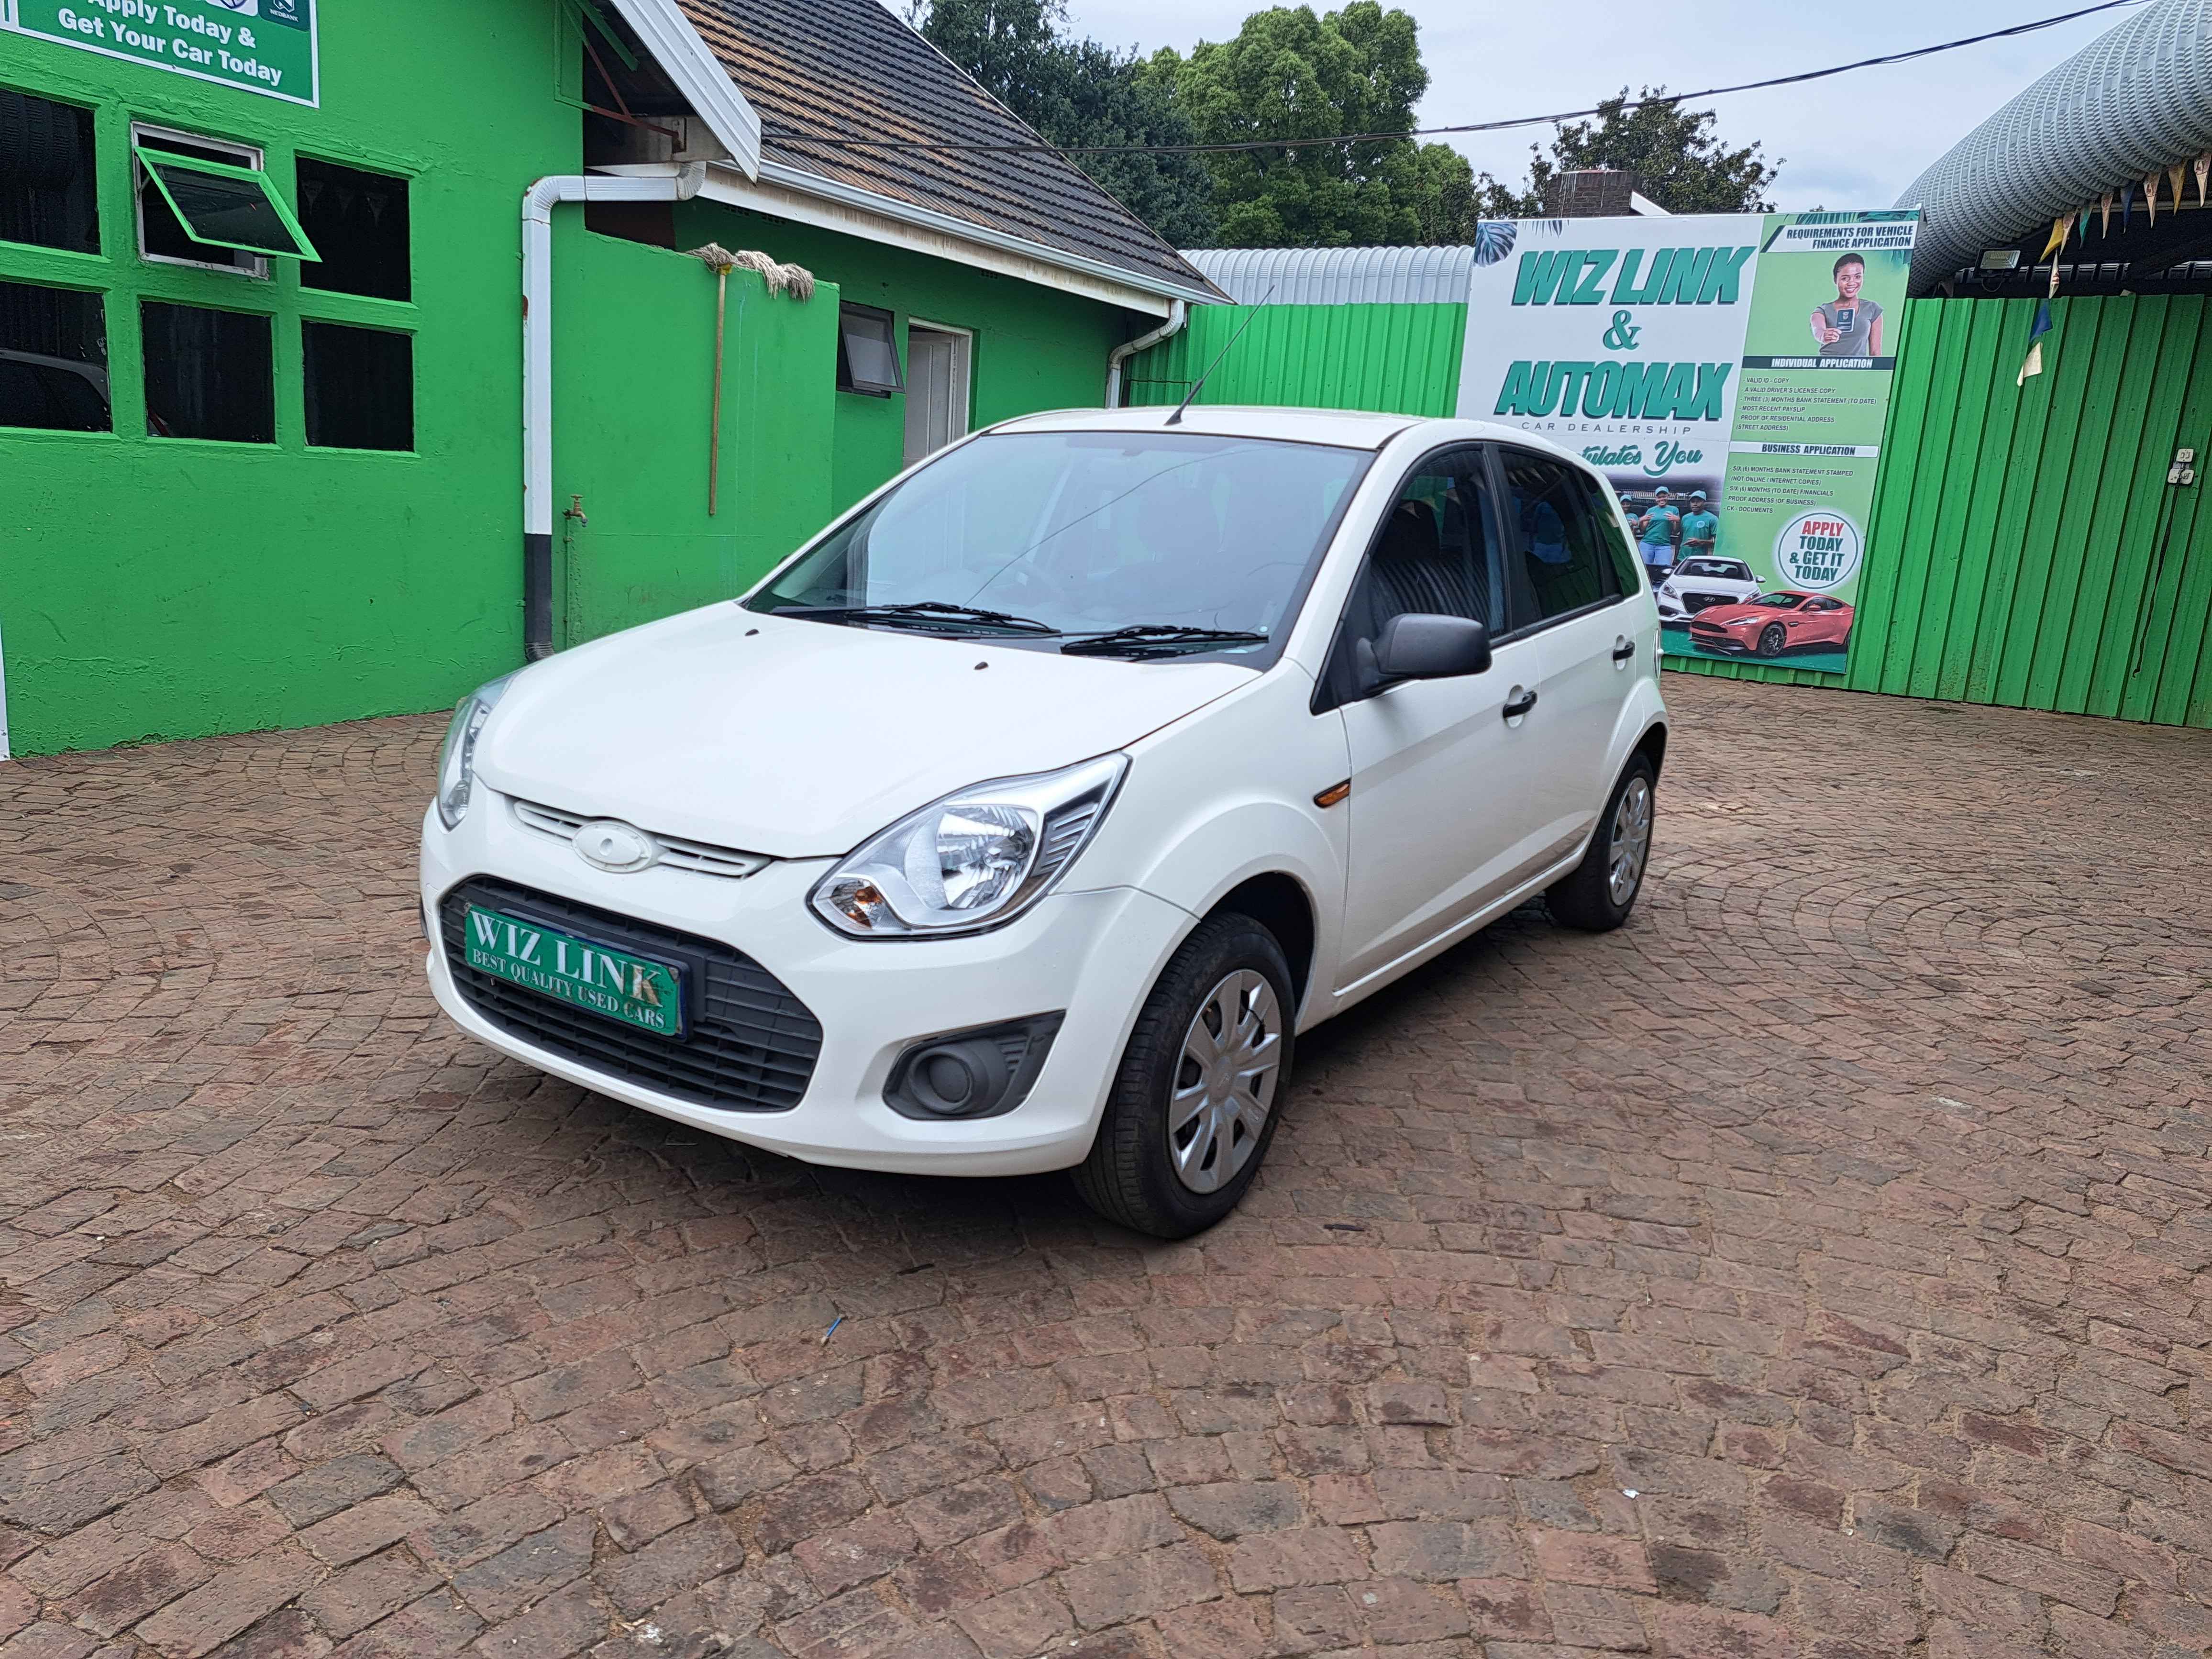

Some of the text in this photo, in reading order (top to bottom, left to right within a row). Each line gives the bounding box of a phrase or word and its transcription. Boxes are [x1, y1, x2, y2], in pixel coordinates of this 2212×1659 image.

[269, 8, 299, 22] NEDBANK
[88, 0, 256, 48] pply Today &
[58, 8, 282, 87] Get Your Car Today
[1787, 226, 1913, 239] REQUIREMENTS FOR VEHICLE
[1812, 237, 1912, 249] FINANCE APPLICATION
[1511, 246, 1758, 305] WIZ LINK
[1603, 310, 1642, 350] &
[1771, 359, 1873, 368] INDIVIDUAL APPLICATION
[1493, 361, 1733, 421] AUTOMAX
[1522, 422, 1692, 434] CAR DEALERSHIP
[1762, 444, 1856, 455] BUSINESS APPLICATION
[1643, 441, 1703, 478] You
[1802, 521, 1844, 536] APPLY
[1800, 536, 1843, 552] TODAY
[1789, 551, 1845, 567] & GET IT
[1795, 565, 1838, 581] TODAY
[470, 910, 663, 1007] WIZ LINK
[473, 948, 665, 1029] BEST QUALITY USED CARS
